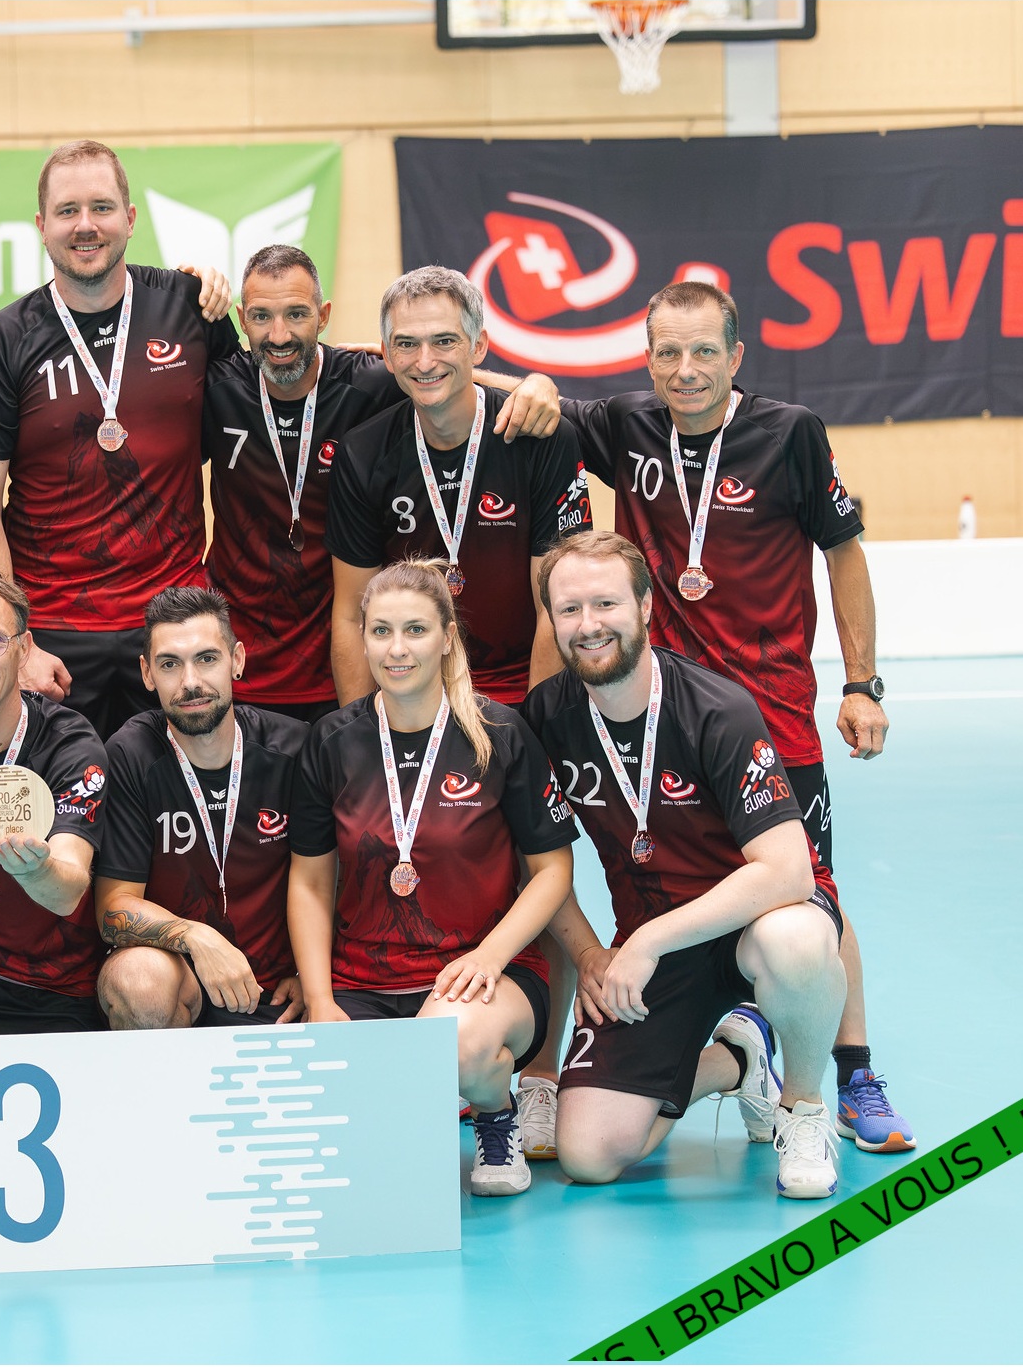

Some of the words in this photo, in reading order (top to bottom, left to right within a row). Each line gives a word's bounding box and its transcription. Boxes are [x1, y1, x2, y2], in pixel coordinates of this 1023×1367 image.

[761, 199, 1023, 351] Swi
[93, 336, 118, 348] erim
[37, 355, 79, 401] 11
[223, 427, 248, 469] 7
[277, 429, 299, 437] rima
[628, 450, 664, 501] 70
[680, 458, 702, 469] rima
[399, 761, 420, 769] erima
[562, 759, 607, 807] 22
[5, 824, 24, 835] place
[156, 811, 197, 855] 19
